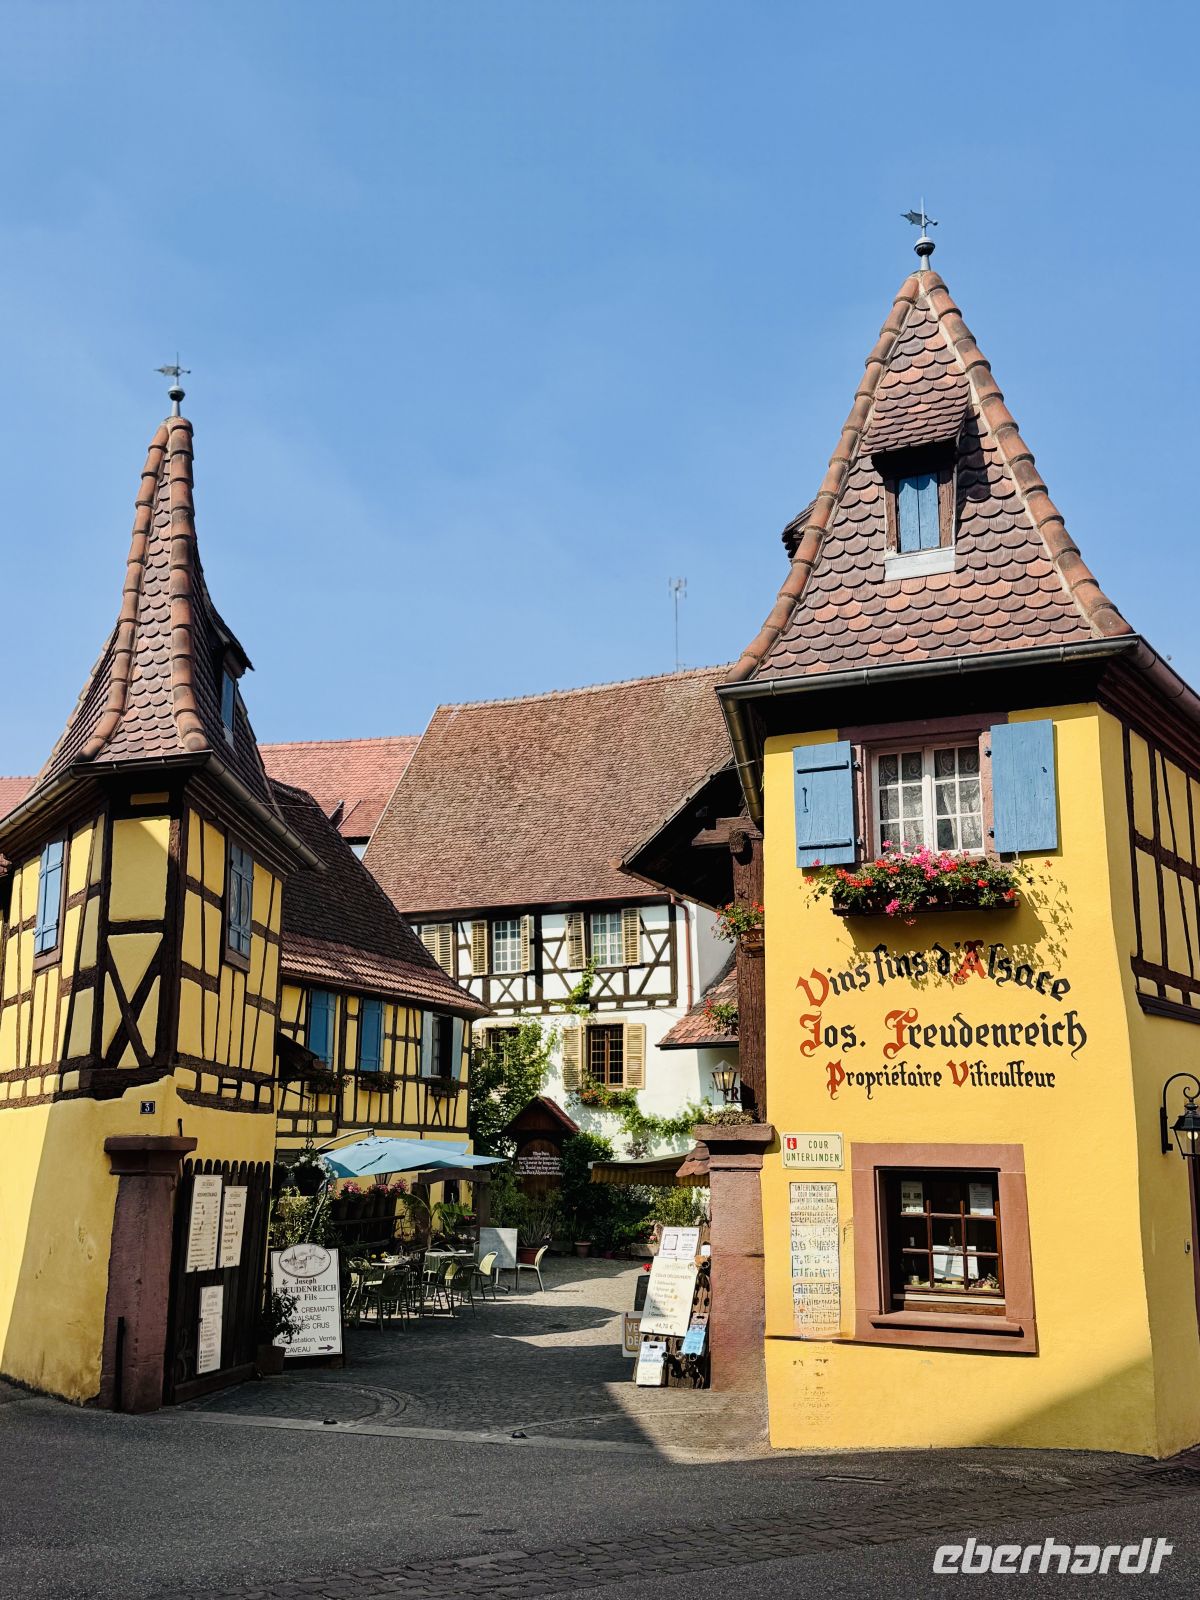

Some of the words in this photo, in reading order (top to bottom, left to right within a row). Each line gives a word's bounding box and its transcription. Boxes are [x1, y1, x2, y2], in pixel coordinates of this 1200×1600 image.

[795, 962, 872, 1007] Vins
[872, 943, 929, 986] fins
[932, 939, 1072, 1002] d'Alsace
[882, 1007, 1088, 1061] Freudenreich
[825, 1059, 943, 1101] Propriétaire
[946, 1060, 1056, 1088] Viticulteur
[808, 1140, 829, 1149] COUR
[786, 1152, 840, 1161] UNTERLINDEN
[295, 1277, 317, 1285] Joseph
[626, 1322, 640, 1332] VE
[285, 1346, 311, 1354] CAVEAU
